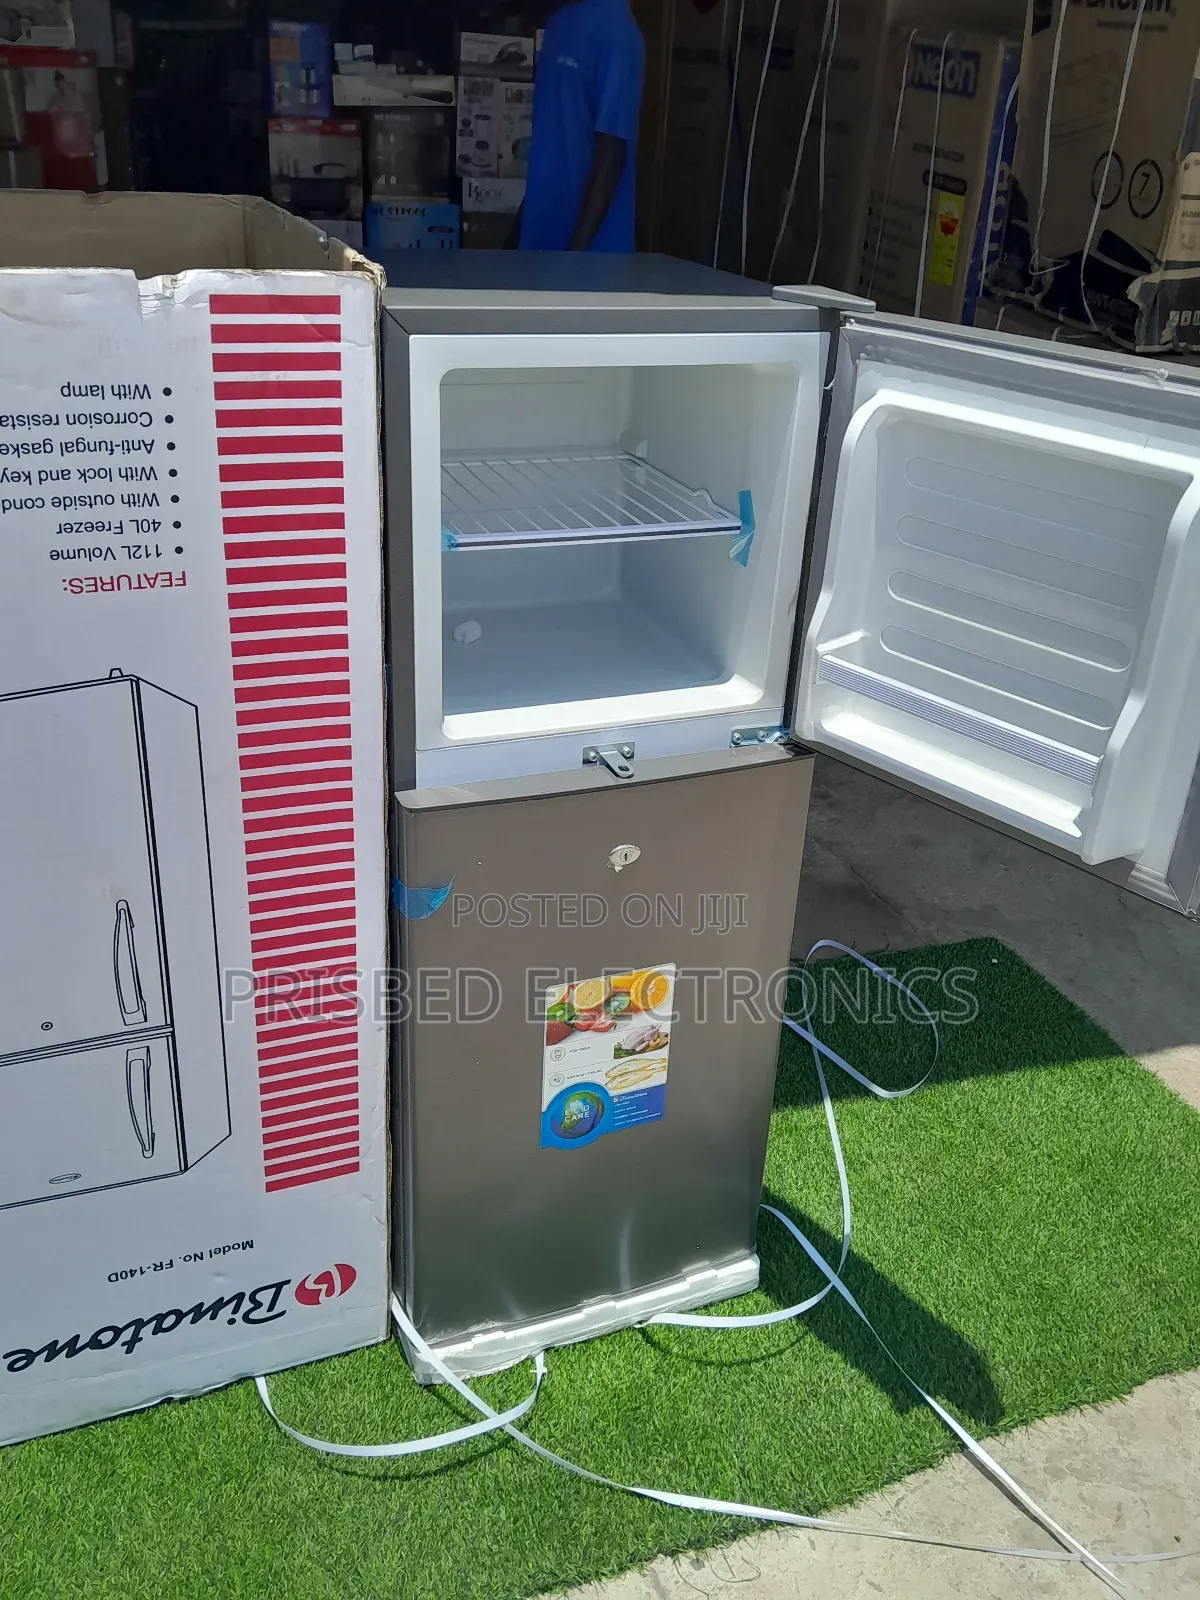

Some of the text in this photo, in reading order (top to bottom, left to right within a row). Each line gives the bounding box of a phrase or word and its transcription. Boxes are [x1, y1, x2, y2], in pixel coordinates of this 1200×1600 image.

[914, 51, 976, 93] Neon
[1141, 172, 1153, 196] 7
[60, 382, 152, 400] With lamp
[0, 411, 153, 430] Corrosion resista
[0, 437, 155, 458] Anti-fungal gaske
[0, 466, 158, 486] With lock and key
[2, 492, 160, 514] With outside cond
[56, 519, 162, 536] 40L Freezer
[49, 544, 163, 562] 112L Volume
[61, 570, 187, 594] FEATURES:
[564, 1112, 590, 1123] CARE
[565, 1104, 590, 1116] ECO
[106, 1239, 254, 1283] Model No. FR-140D
[3, 1279, 292, 1373] Binatone
